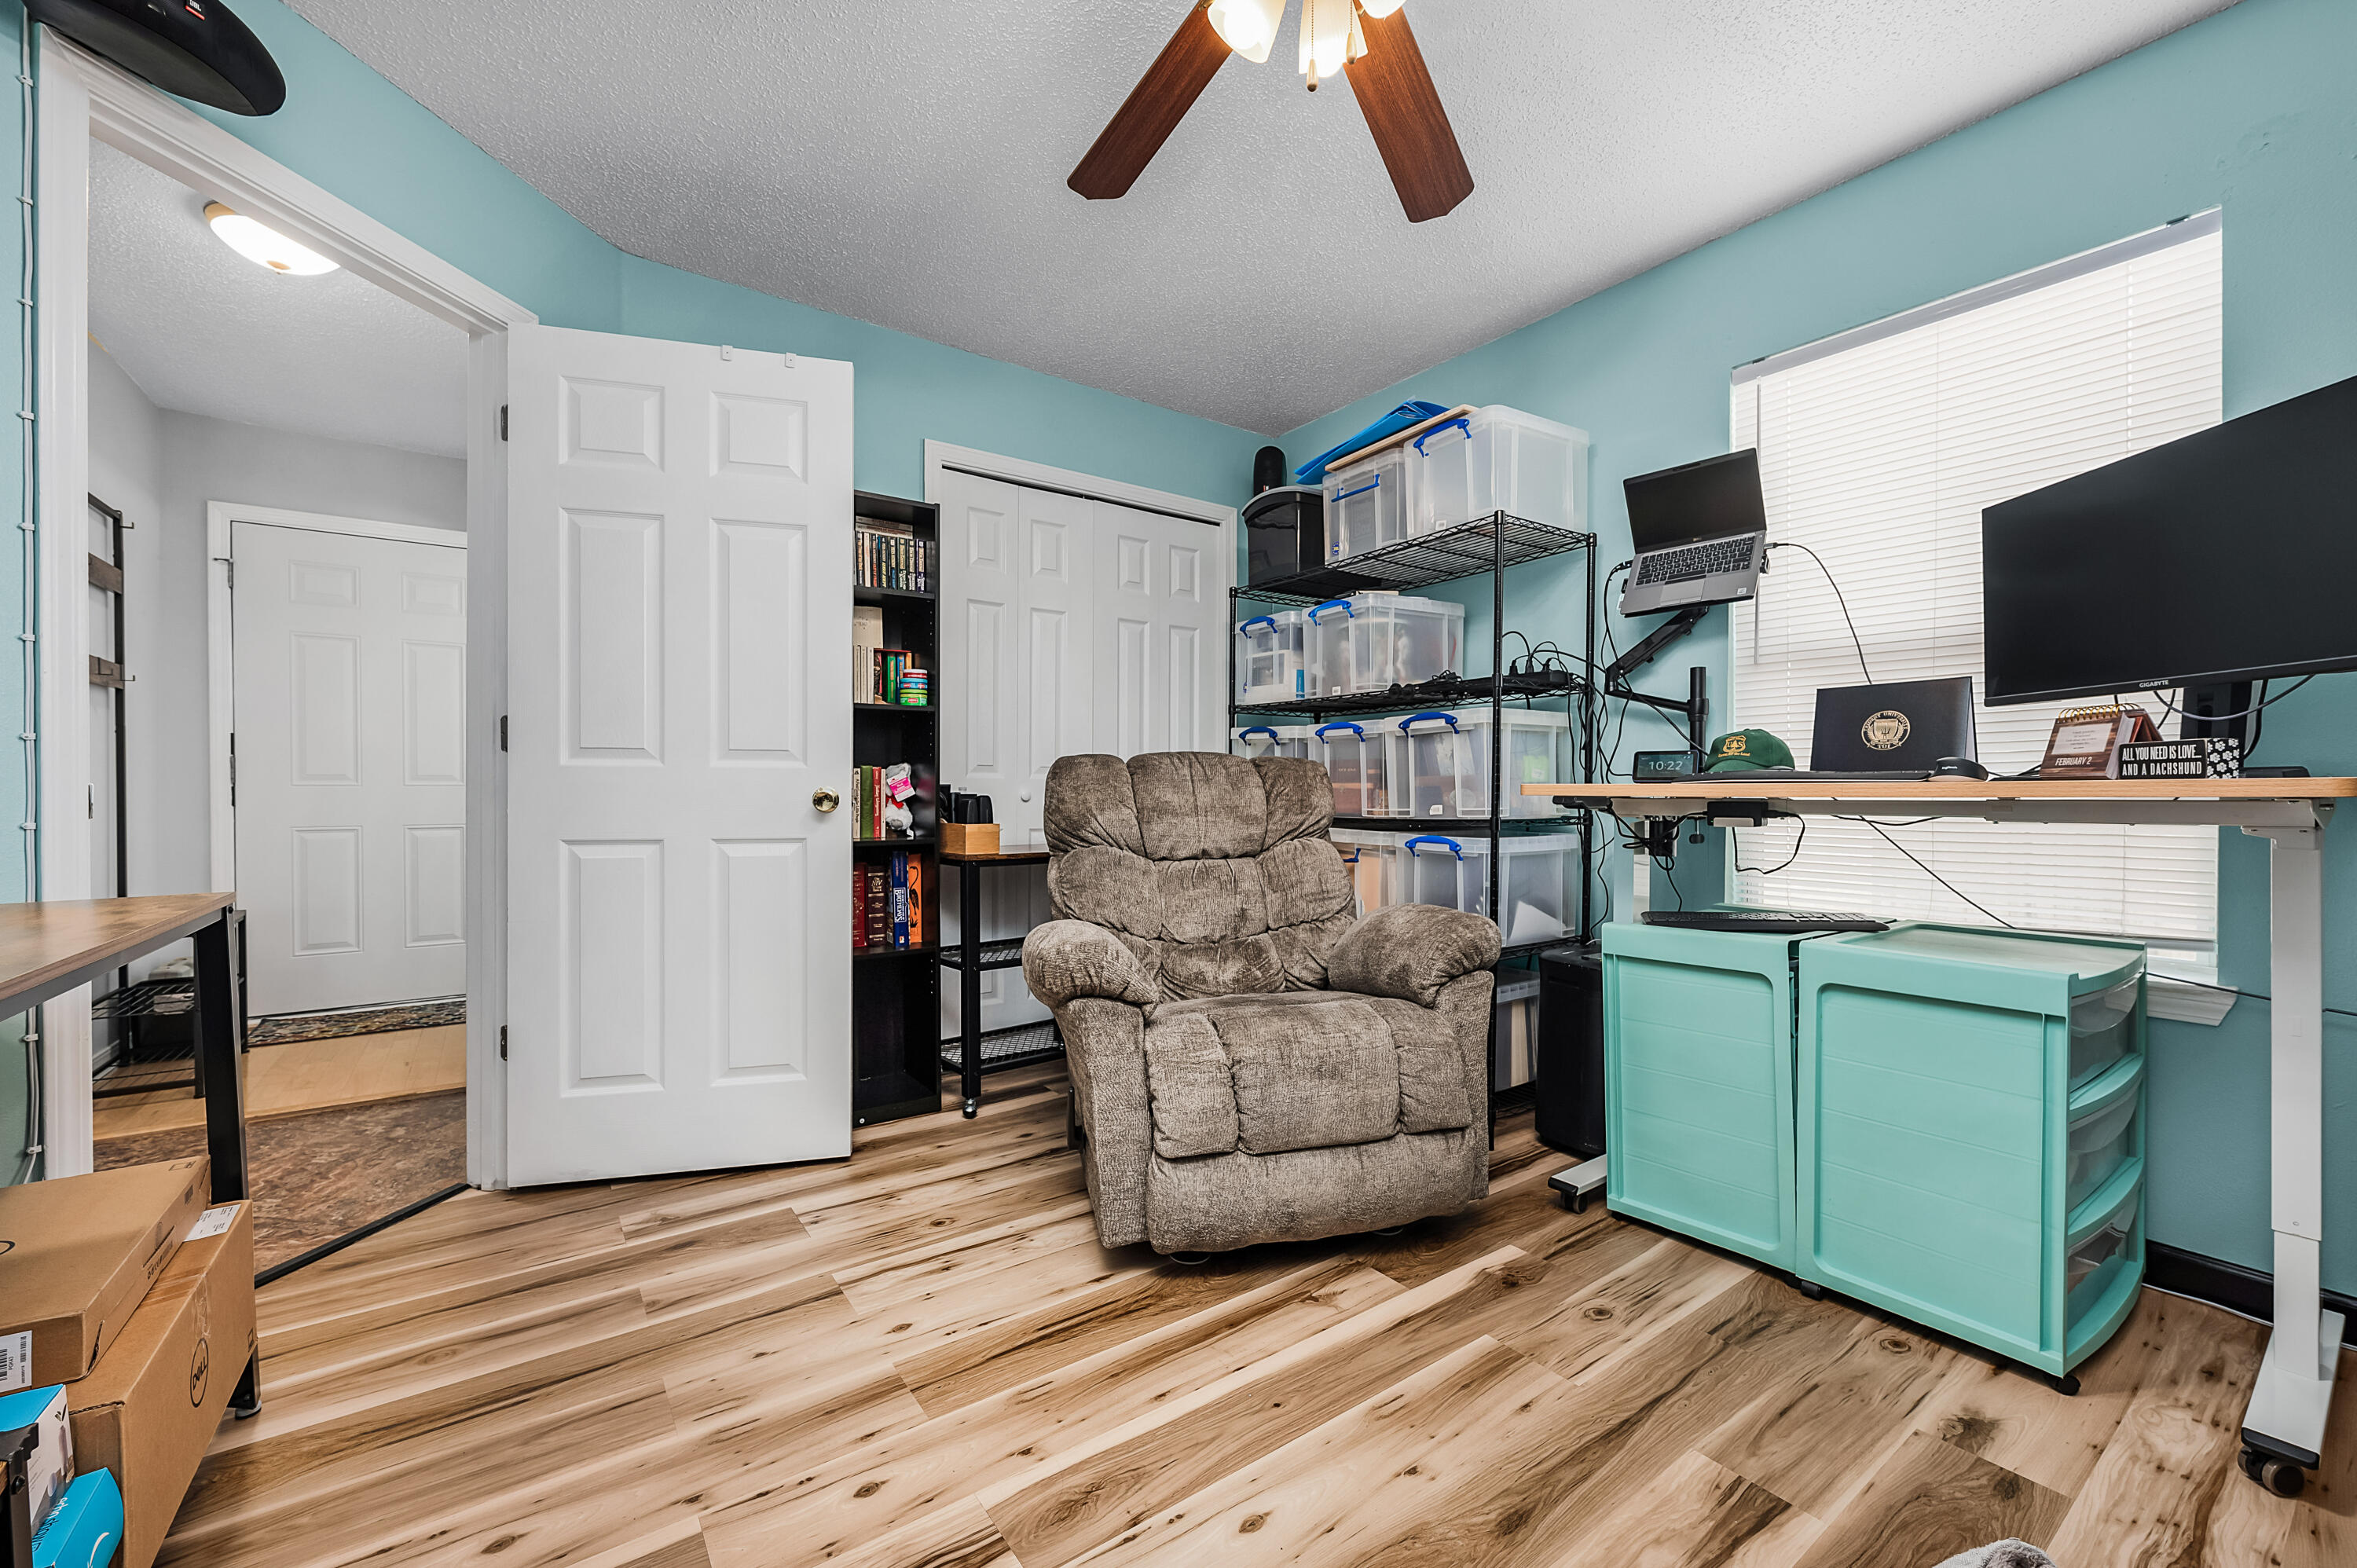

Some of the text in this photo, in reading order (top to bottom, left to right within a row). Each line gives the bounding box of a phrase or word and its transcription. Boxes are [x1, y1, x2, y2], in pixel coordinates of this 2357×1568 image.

[2139, 680, 2169, 688] GIGABYTE
[2122, 748, 2135, 761] ALL
[2135, 747, 2150, 760] YOU
[2150, 746, 2168, 760] NEED
[2168, 746, 2177, 760] IS
[1648, 760, 1683, 771] 10:22
[2055, 756, 2093, 766] FEBRUARY 2
[2122, 761, 2202, 776] AND A DACHSHUND
[192, 1356, 207, 1390] DELL
